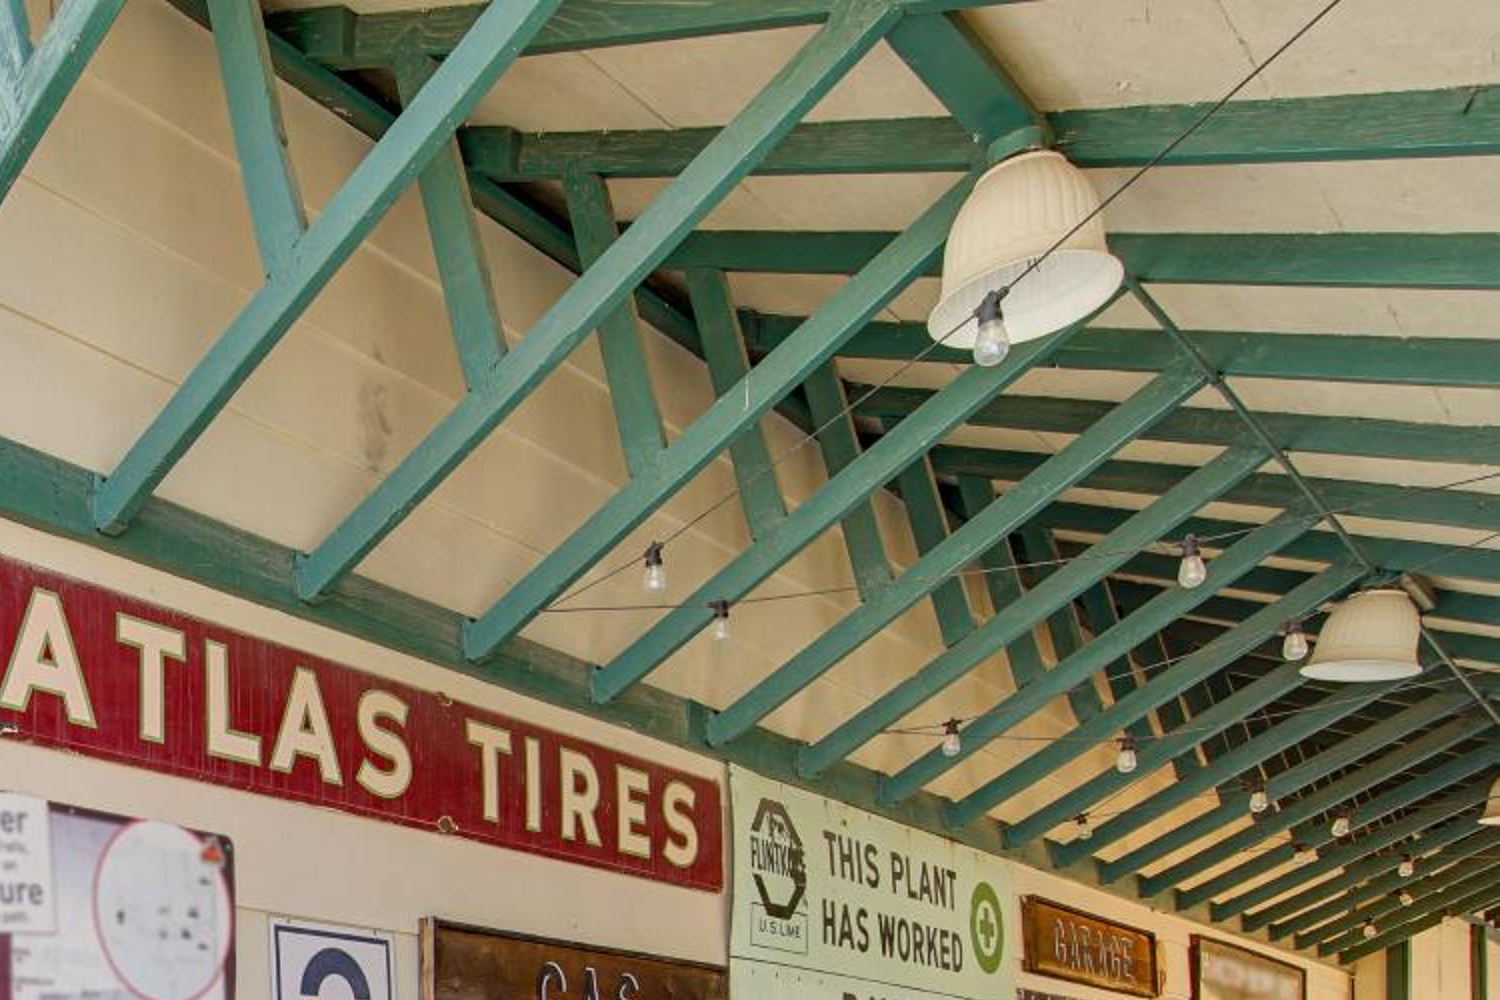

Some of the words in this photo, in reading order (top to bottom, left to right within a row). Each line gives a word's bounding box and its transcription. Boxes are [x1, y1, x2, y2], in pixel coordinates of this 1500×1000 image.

[466, 718, 700, 870] TIRES
[823, 829, 880, 889] THIS
[891, 851, 957, 911] PLANT
[822, 898, 870, 953] HAS
[878, 911, 964, 973] WORKED
[1053, 917, 1136, 979] GARAGE
